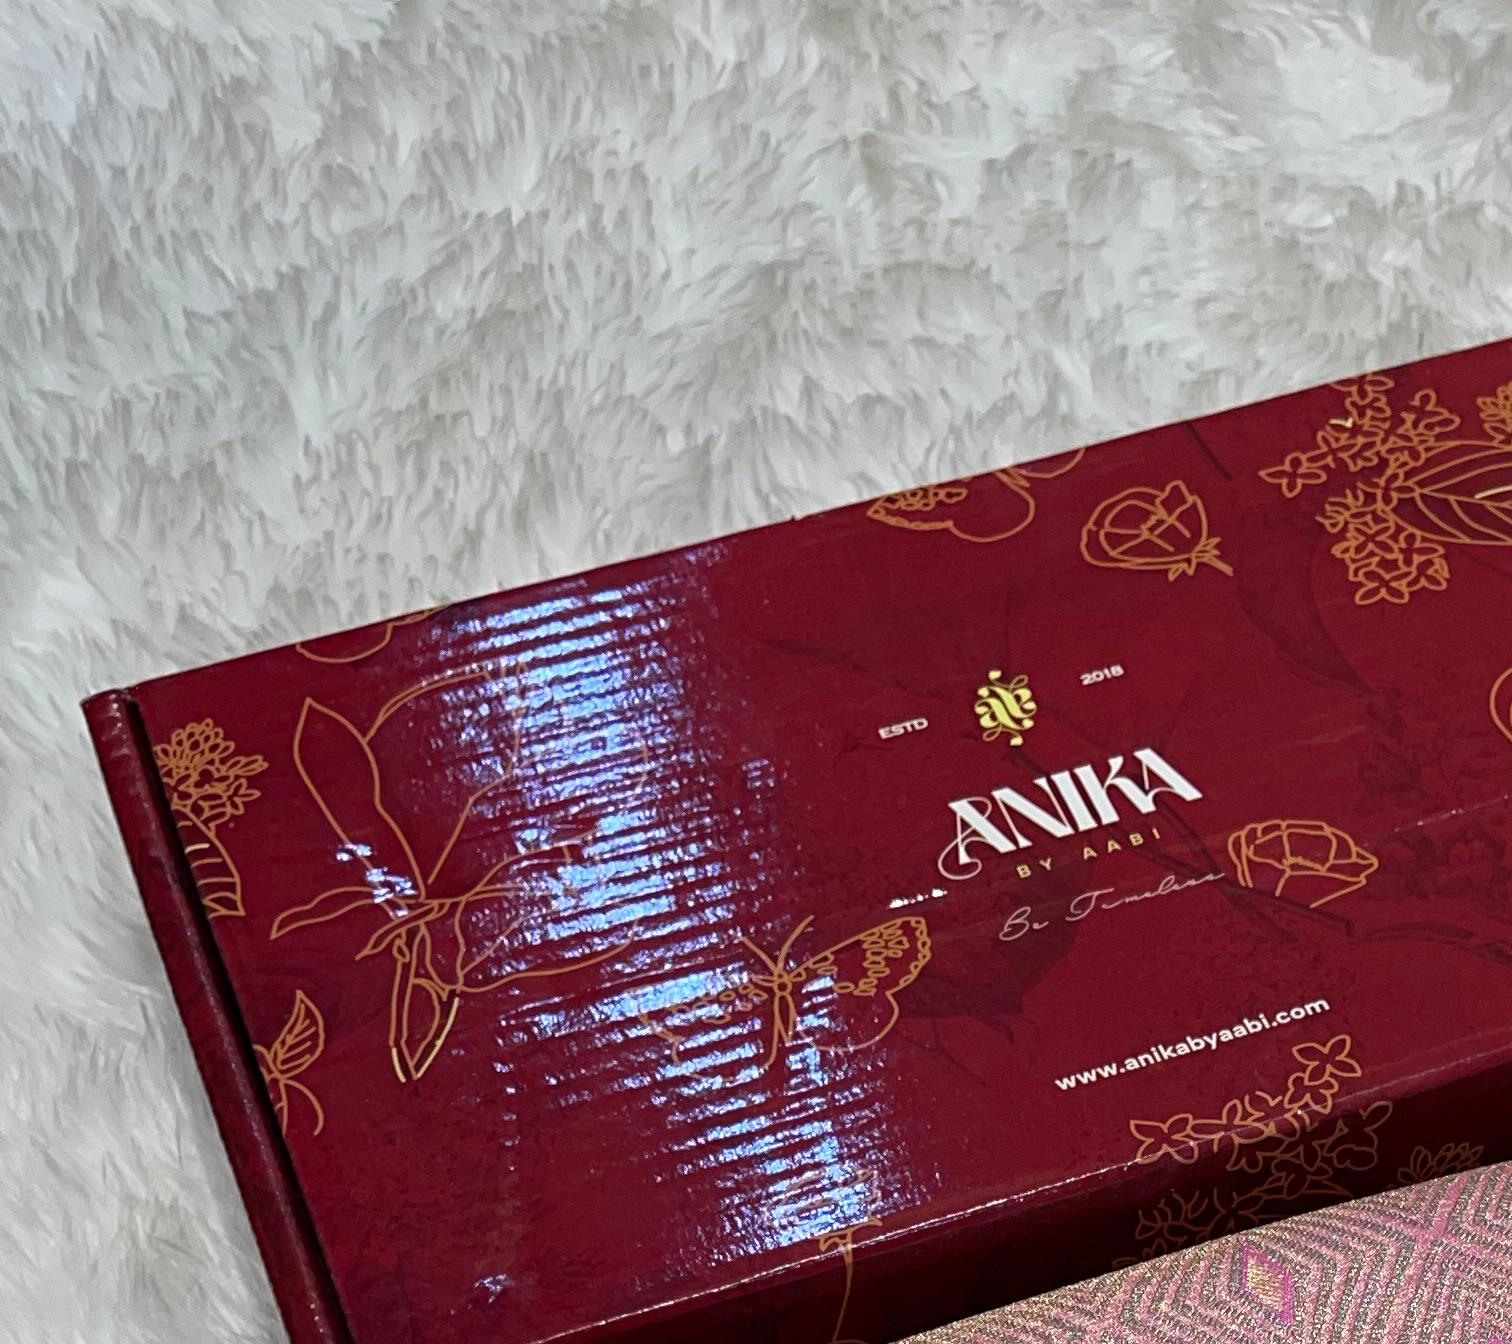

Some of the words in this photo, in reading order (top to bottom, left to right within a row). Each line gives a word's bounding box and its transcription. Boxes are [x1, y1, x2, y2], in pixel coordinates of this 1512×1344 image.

[878, 717, 929, 740] ESTD
[1081, 664, 1124, 686] 2018
[938, 747, 1203, 880] ANIKA
[1016, 857, 1052, 879] BY
[1082, 827, 1160, 860] AABI
[999, 906, 1049, 941] Be
[1055, 999, 1331, 1091] www.anikabyaabi.com
